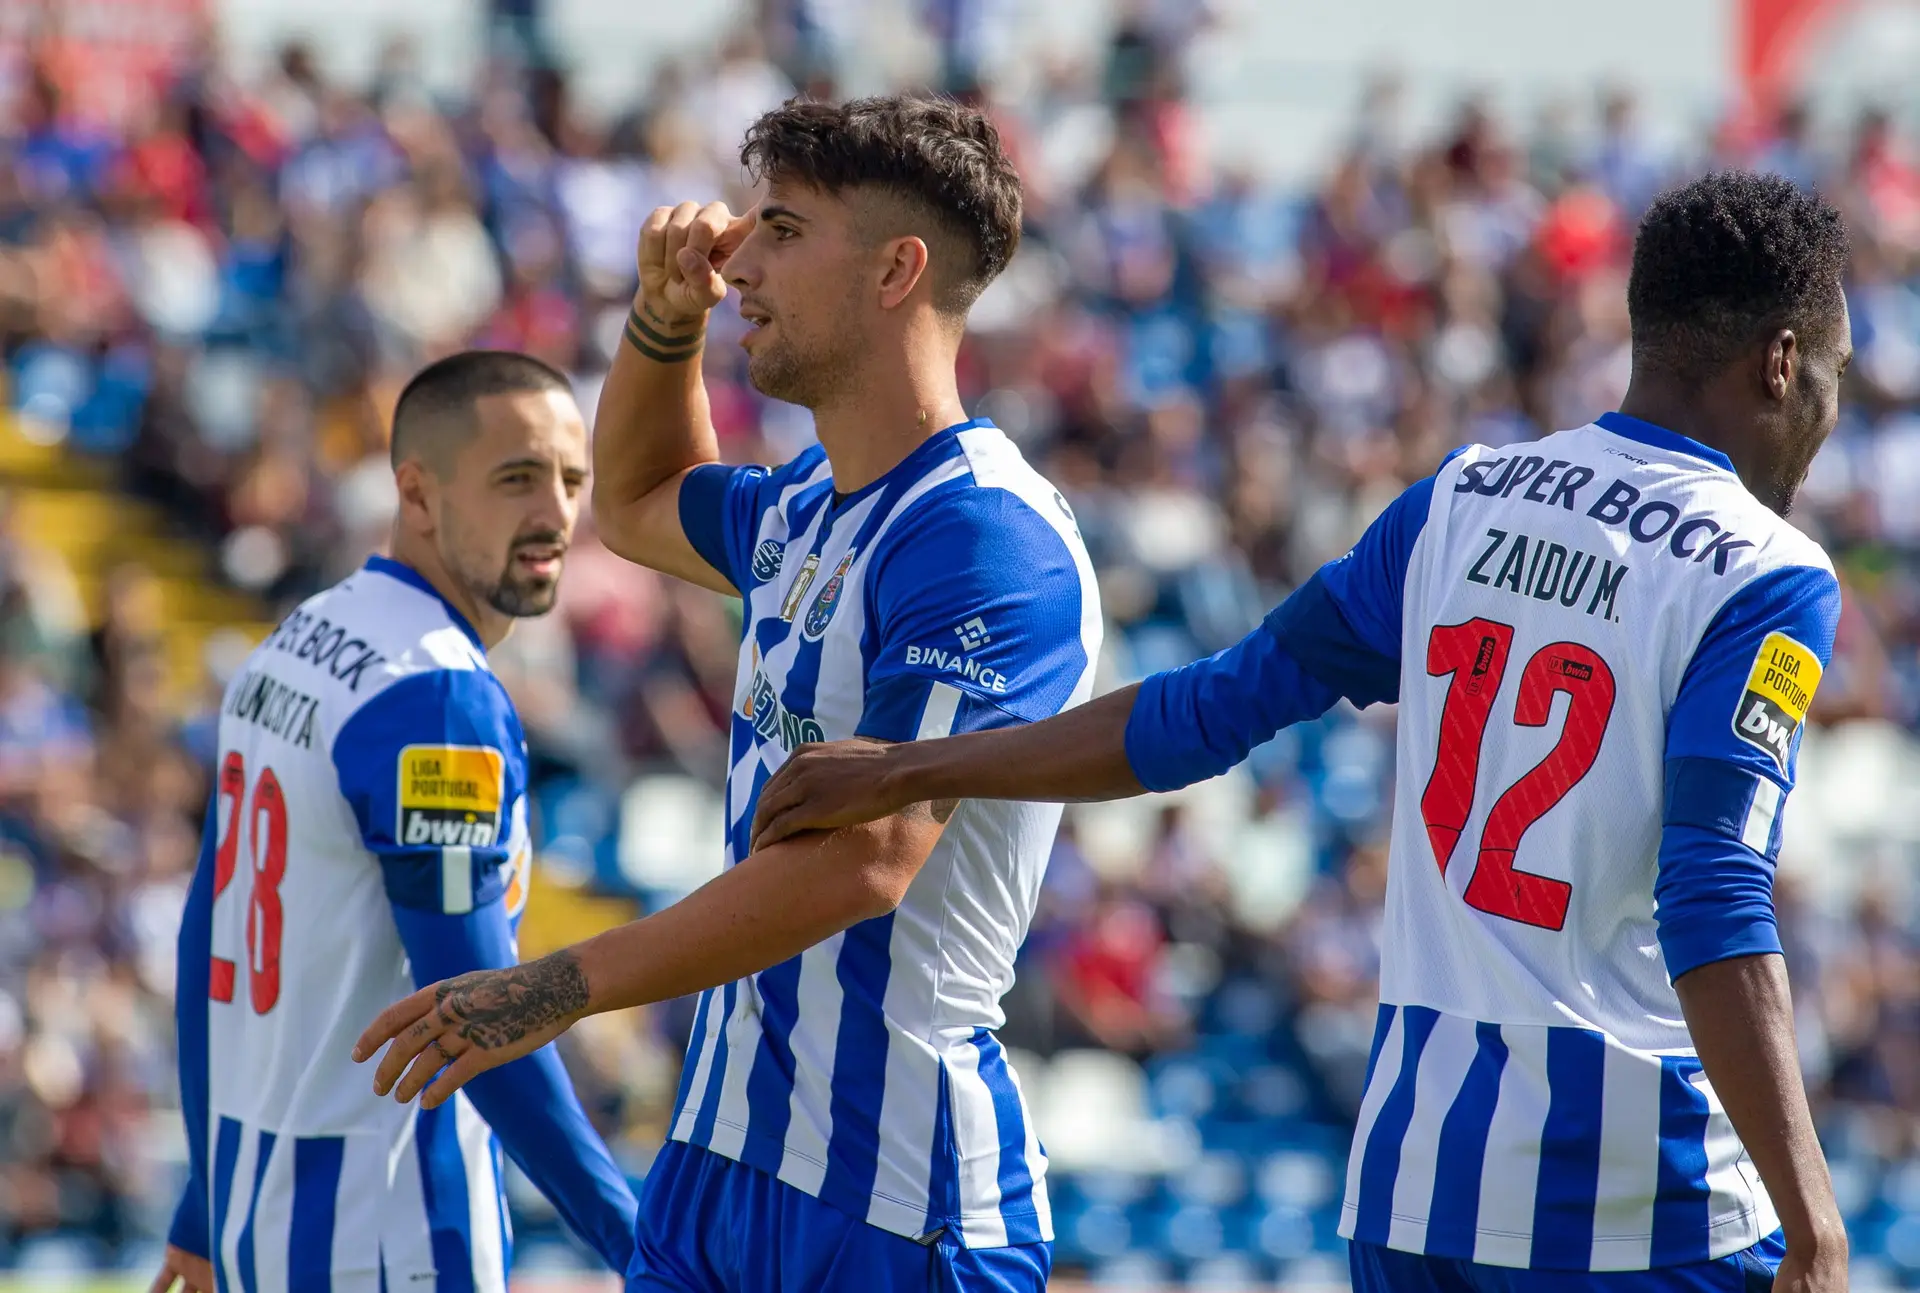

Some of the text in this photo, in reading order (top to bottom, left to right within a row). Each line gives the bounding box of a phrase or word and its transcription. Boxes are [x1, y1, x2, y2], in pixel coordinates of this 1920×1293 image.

[1618, 452, 1649, 467] Porto
[1454, 455, 1756, 576] SUPER BOCK
[1466, 528, 1598, 608] ZAIDU
[296, 617, 387, 693] BOCK
[905, 645, 1007, 693] BINANCE
[1564, 664, 1590, 680] bwin
[1770, 647, 1801, 679] LIGA
[411, 759, 442, 777] LIGA
[1420, 616, 1617, 932] 12
[411, 780, 479, 800] PORTUGAL
[405, 810, 493, 847] bwin
[208, 749, 289, 1016] 28
